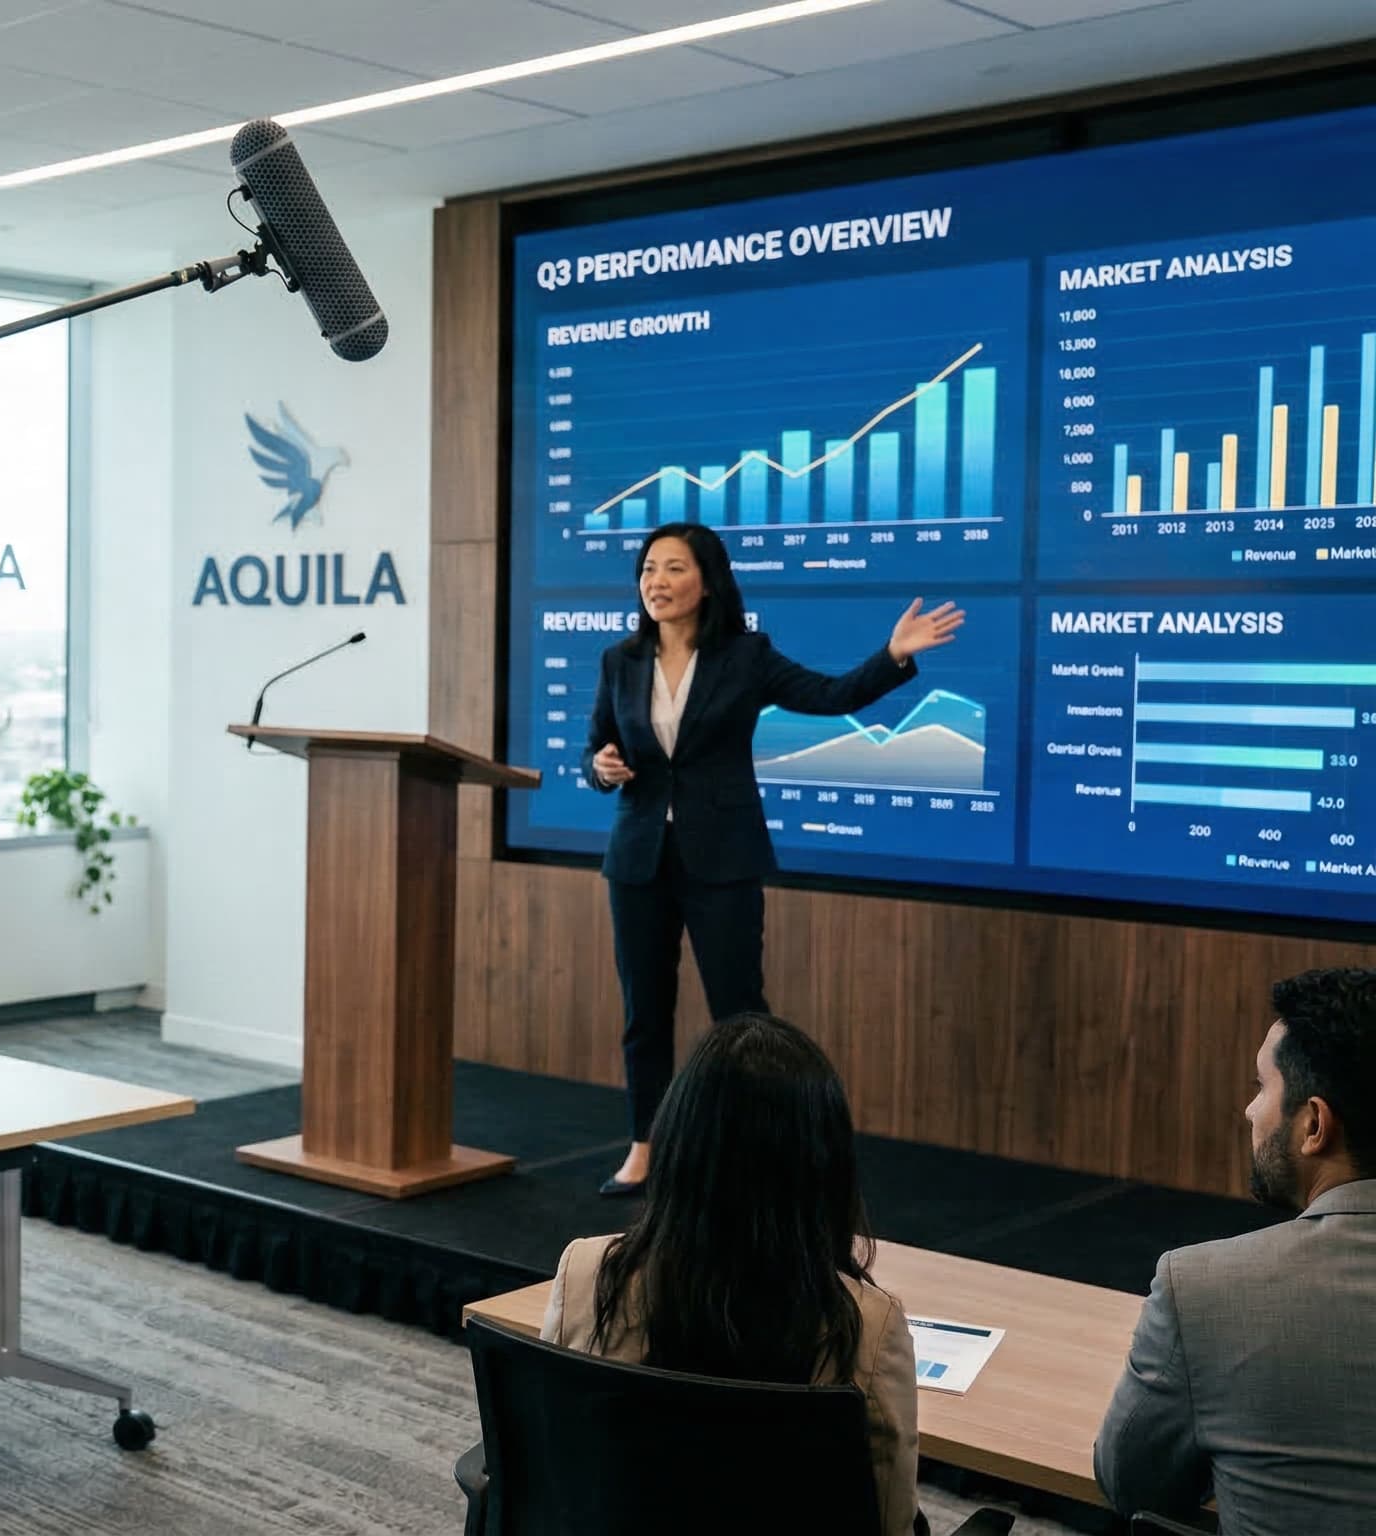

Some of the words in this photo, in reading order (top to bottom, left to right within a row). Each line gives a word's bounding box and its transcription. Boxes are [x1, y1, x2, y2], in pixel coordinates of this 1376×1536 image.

[536, 259, 571, 290] Q3
[577, 230, 783, 283] PERFORMANCE
[789, 207, 952, 256] OVERVIEW
[1059, 259, 1162, 291] MARKET
[1166, 245, 1293, 279] ANALYSIS
[547, 320, 626, 346] REVENUE
[629, 310, 710, 337] GROWTH
[1083, 510, 1092, 521] 0
[193, 552, 407, 606] AQUILA
[543, 611, 624, 632] REVENUE
[1051, 612, 1153, 634] MARKET
[1158, 612, 1283, 635] ANALYSIS
[1189, 824, 1211, 837] 200
[1258, 829, 1282, 841] 400
[1330, 834, 1355, 846] 600
[1239, 855, 1290, 870] Revenue
[1319, 861, 1362, 876] Market
[1365, 864, 1376, 876] A
